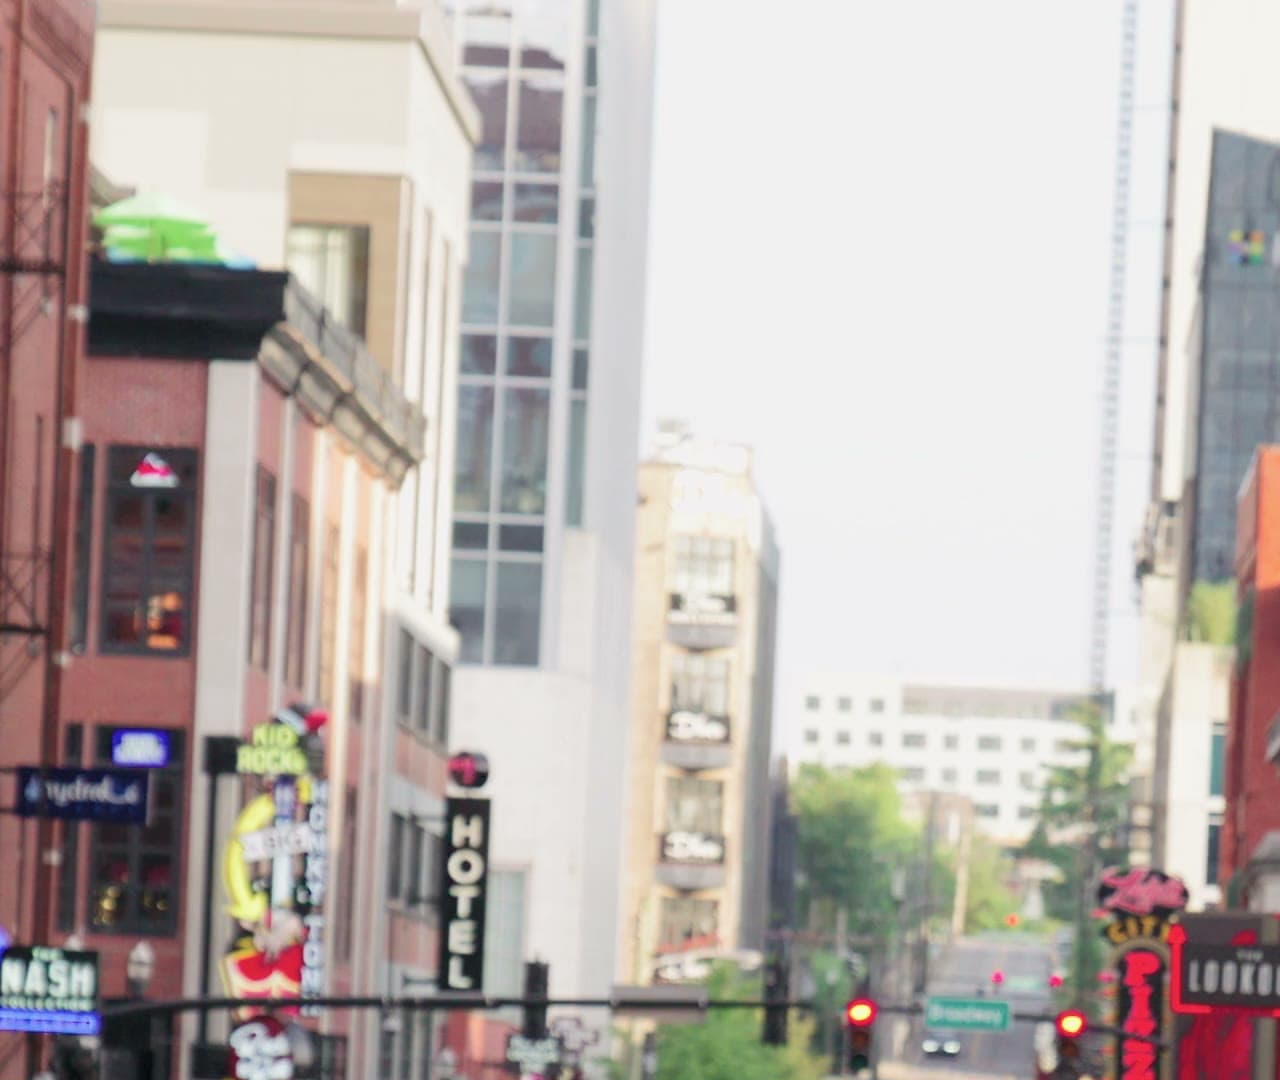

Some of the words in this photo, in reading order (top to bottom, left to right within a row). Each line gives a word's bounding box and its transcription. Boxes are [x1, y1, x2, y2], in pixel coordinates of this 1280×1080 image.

[253, 724, 299, 748] KID
[447, 815, 485, 989] HOTEL
[1, 957, 95, 997] NASH
